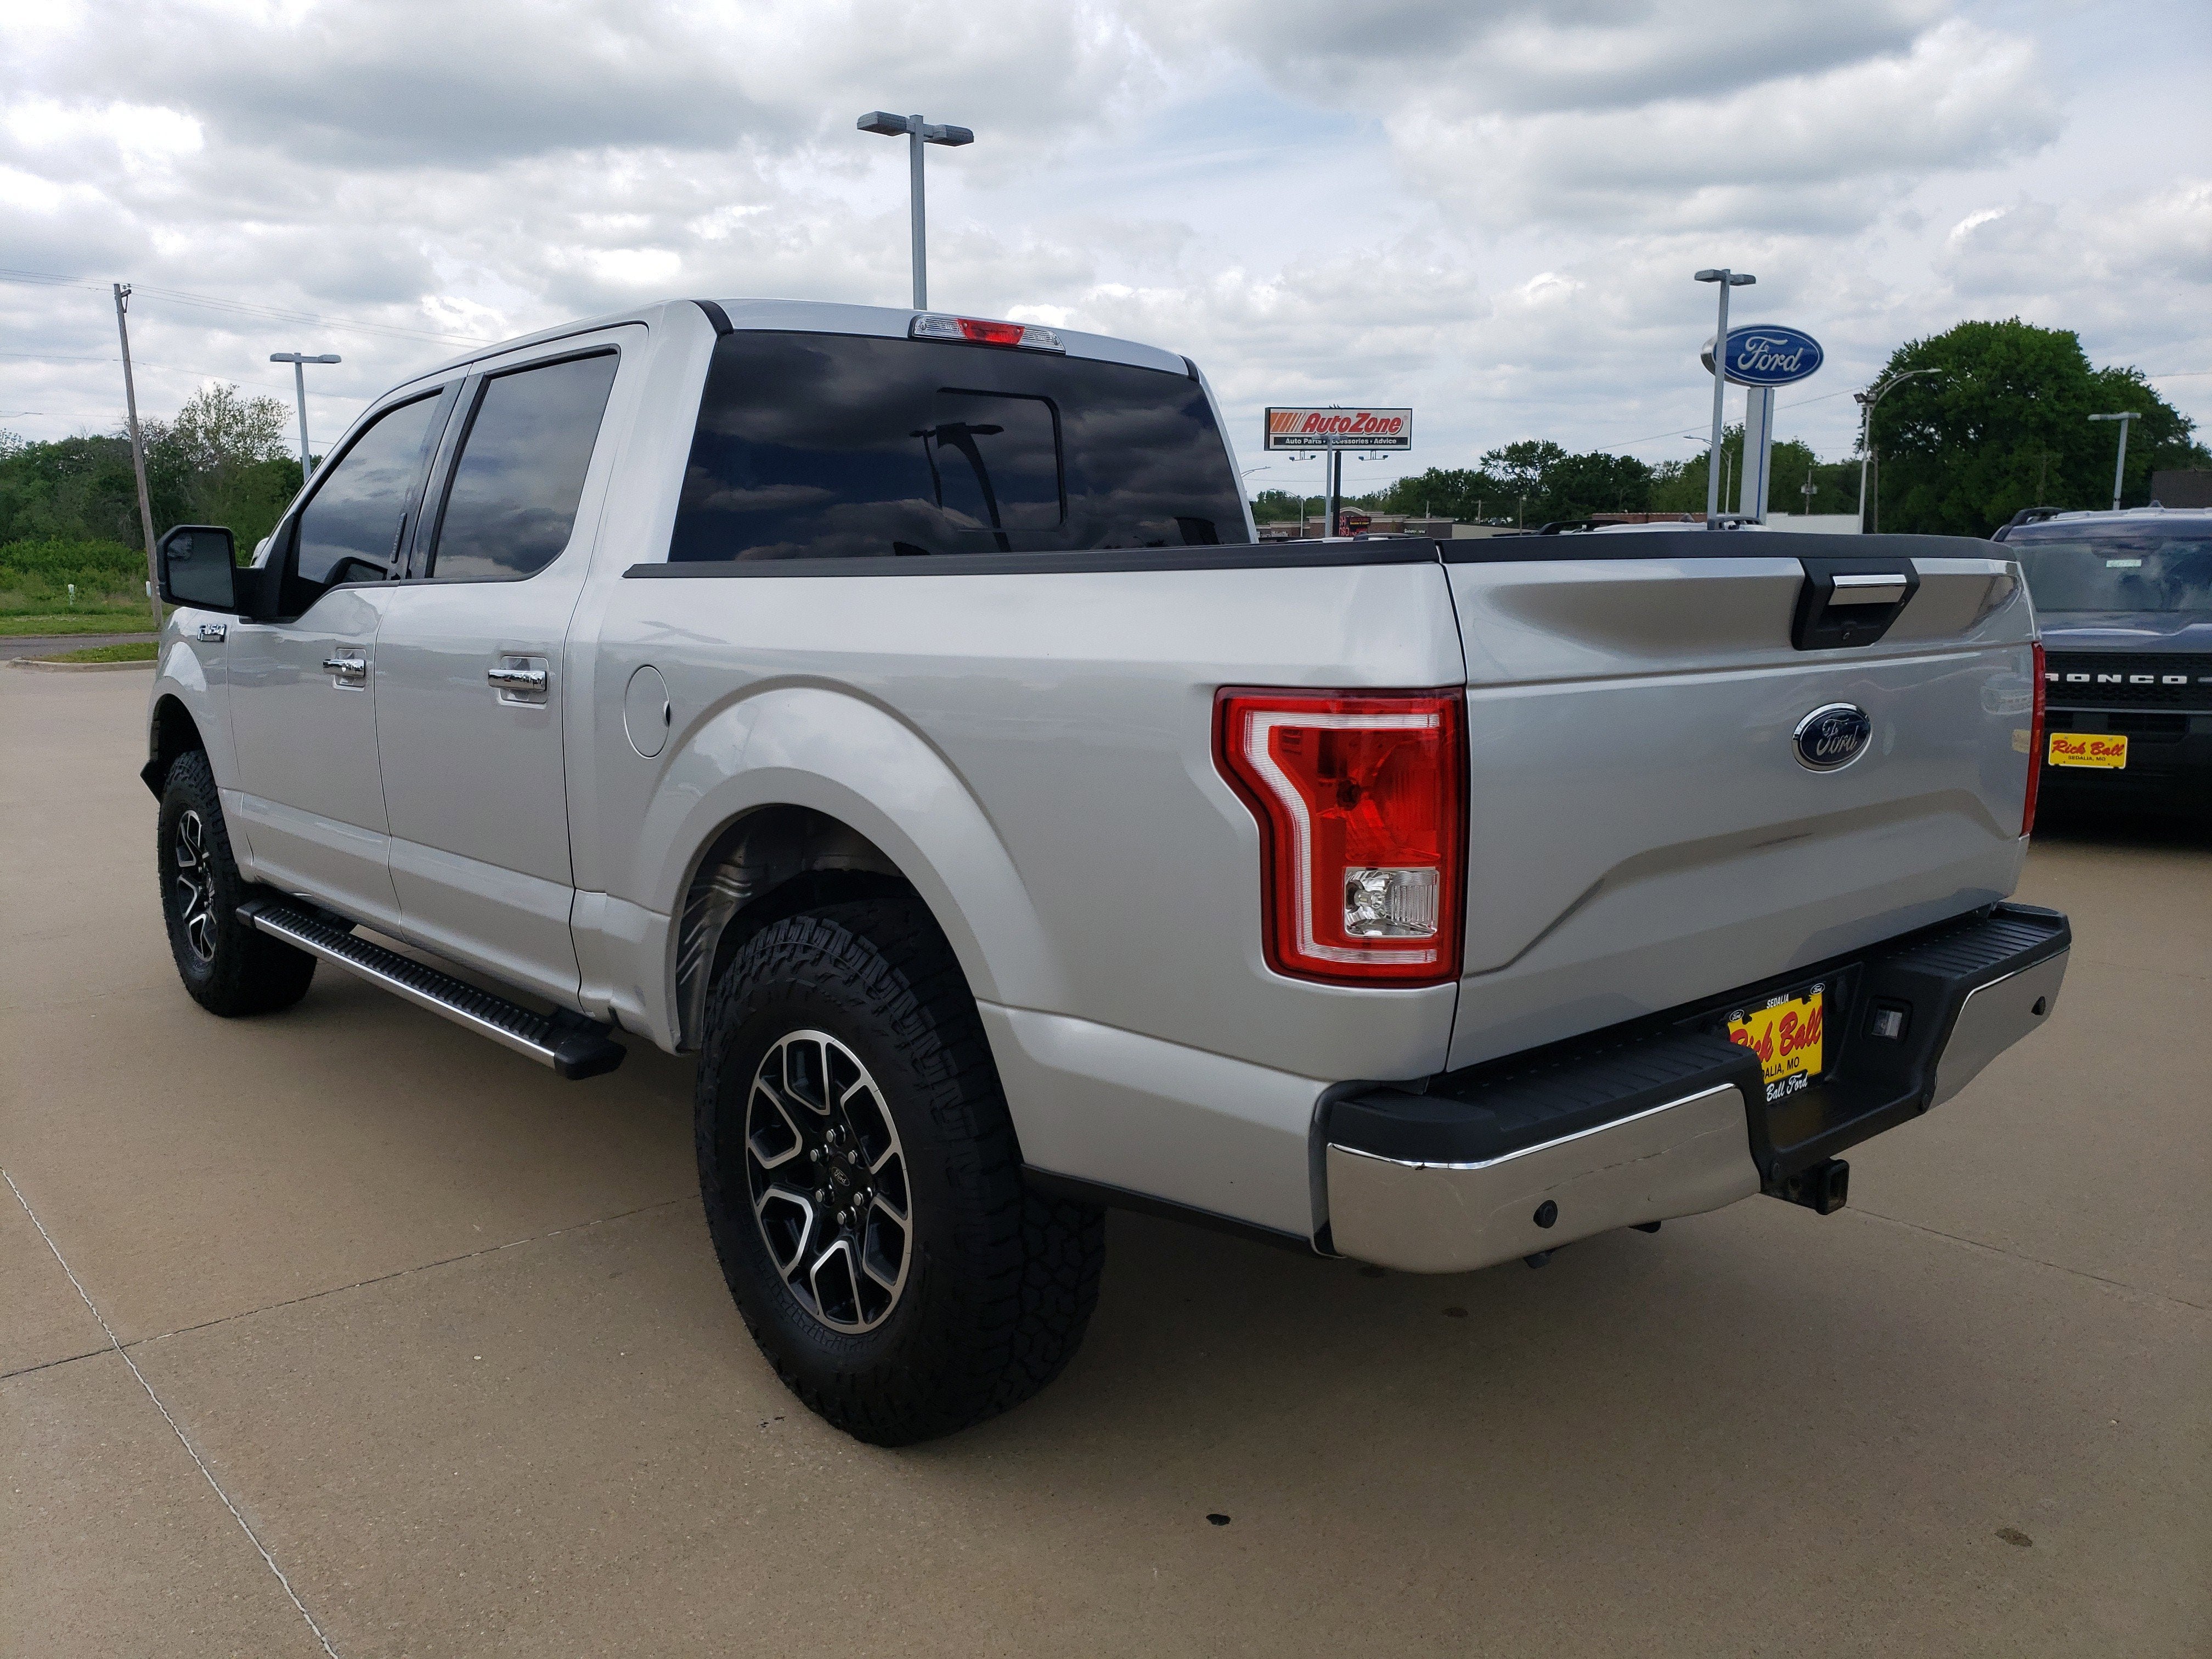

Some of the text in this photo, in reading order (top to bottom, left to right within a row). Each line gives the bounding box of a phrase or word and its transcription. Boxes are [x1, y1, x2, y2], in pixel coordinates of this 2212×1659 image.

[1737, 336, 1803, 373] Ford
[1301, 412, 1402, 434] AutoZone
[1816, 718, 1859, 756] Ford
[2051, 740, 2125, 757] Rick Ball
[1813, 985, 1822, 994] Ford
[1766, 994, 1790, 1009] SEDALIA
[1731, 1012, 1742, 1020] Ford
[1779, 1006, 1822, 1056] Ball
[1787, 1056, 1799, 1070] MO
[1766, 1072, 1808, 1102] Ball Ford
[833, 1170, 847, 1184] Ford
